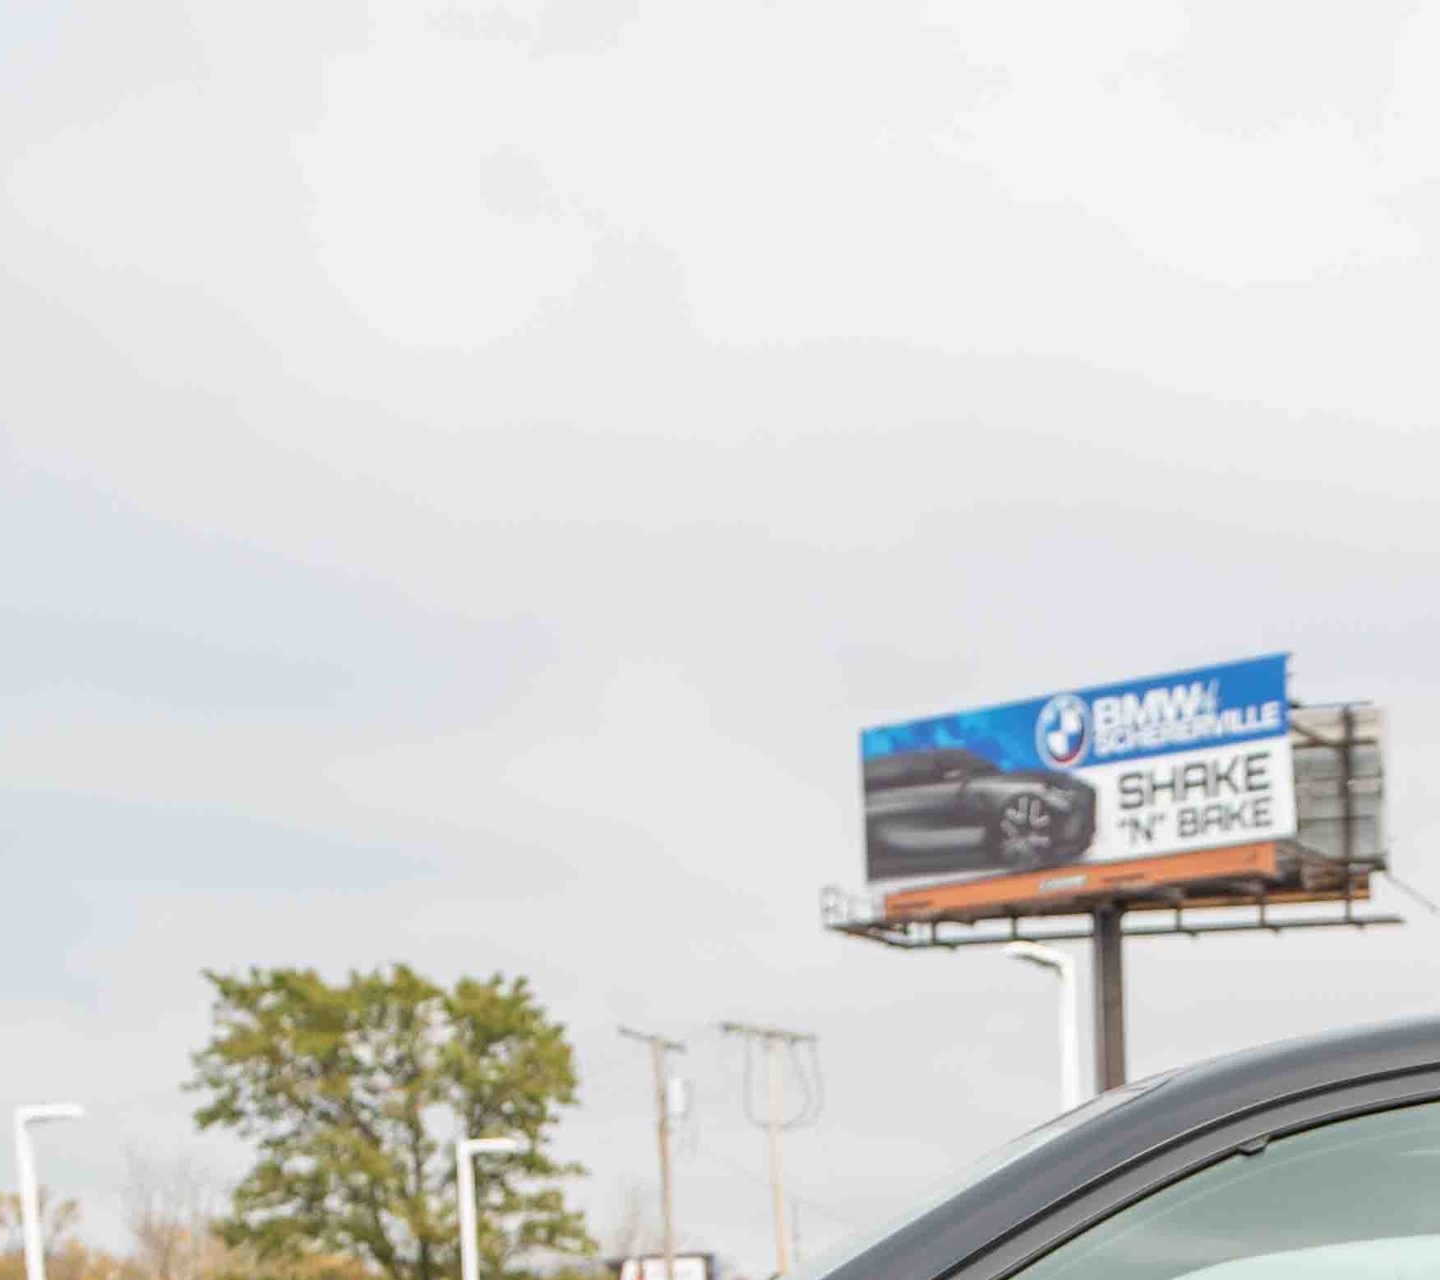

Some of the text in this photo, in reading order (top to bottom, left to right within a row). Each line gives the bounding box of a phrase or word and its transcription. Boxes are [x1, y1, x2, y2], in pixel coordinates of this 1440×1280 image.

[1092, 681, 1203, 727] BMW
[1118, 751, 1270, 810] SHAKE
[1177, 797, 1273, 839] BAKE
